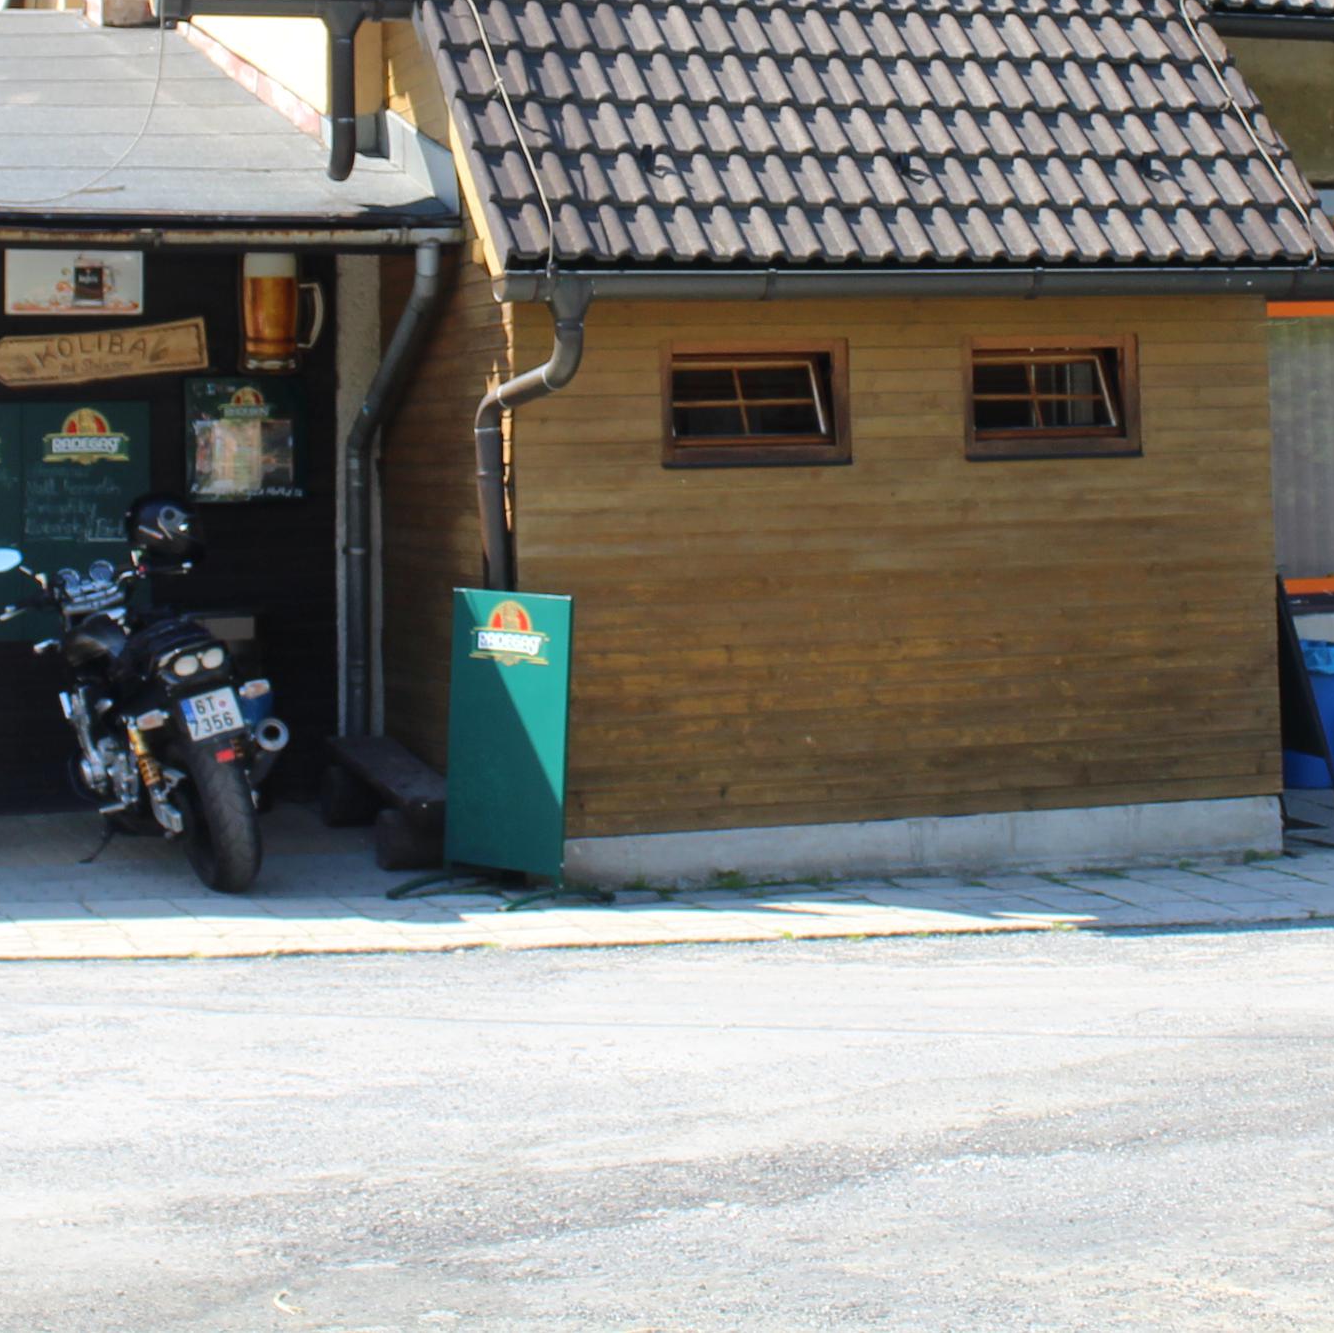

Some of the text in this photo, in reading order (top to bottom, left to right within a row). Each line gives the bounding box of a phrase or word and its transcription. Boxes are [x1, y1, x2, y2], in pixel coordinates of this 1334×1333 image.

[35, 332, 147, 368] KOLIBA
[51, 436, 121, 454] RADEGAST
[195, 695, 216, 716] 6T
[190, 711, 234, 737] 7356
